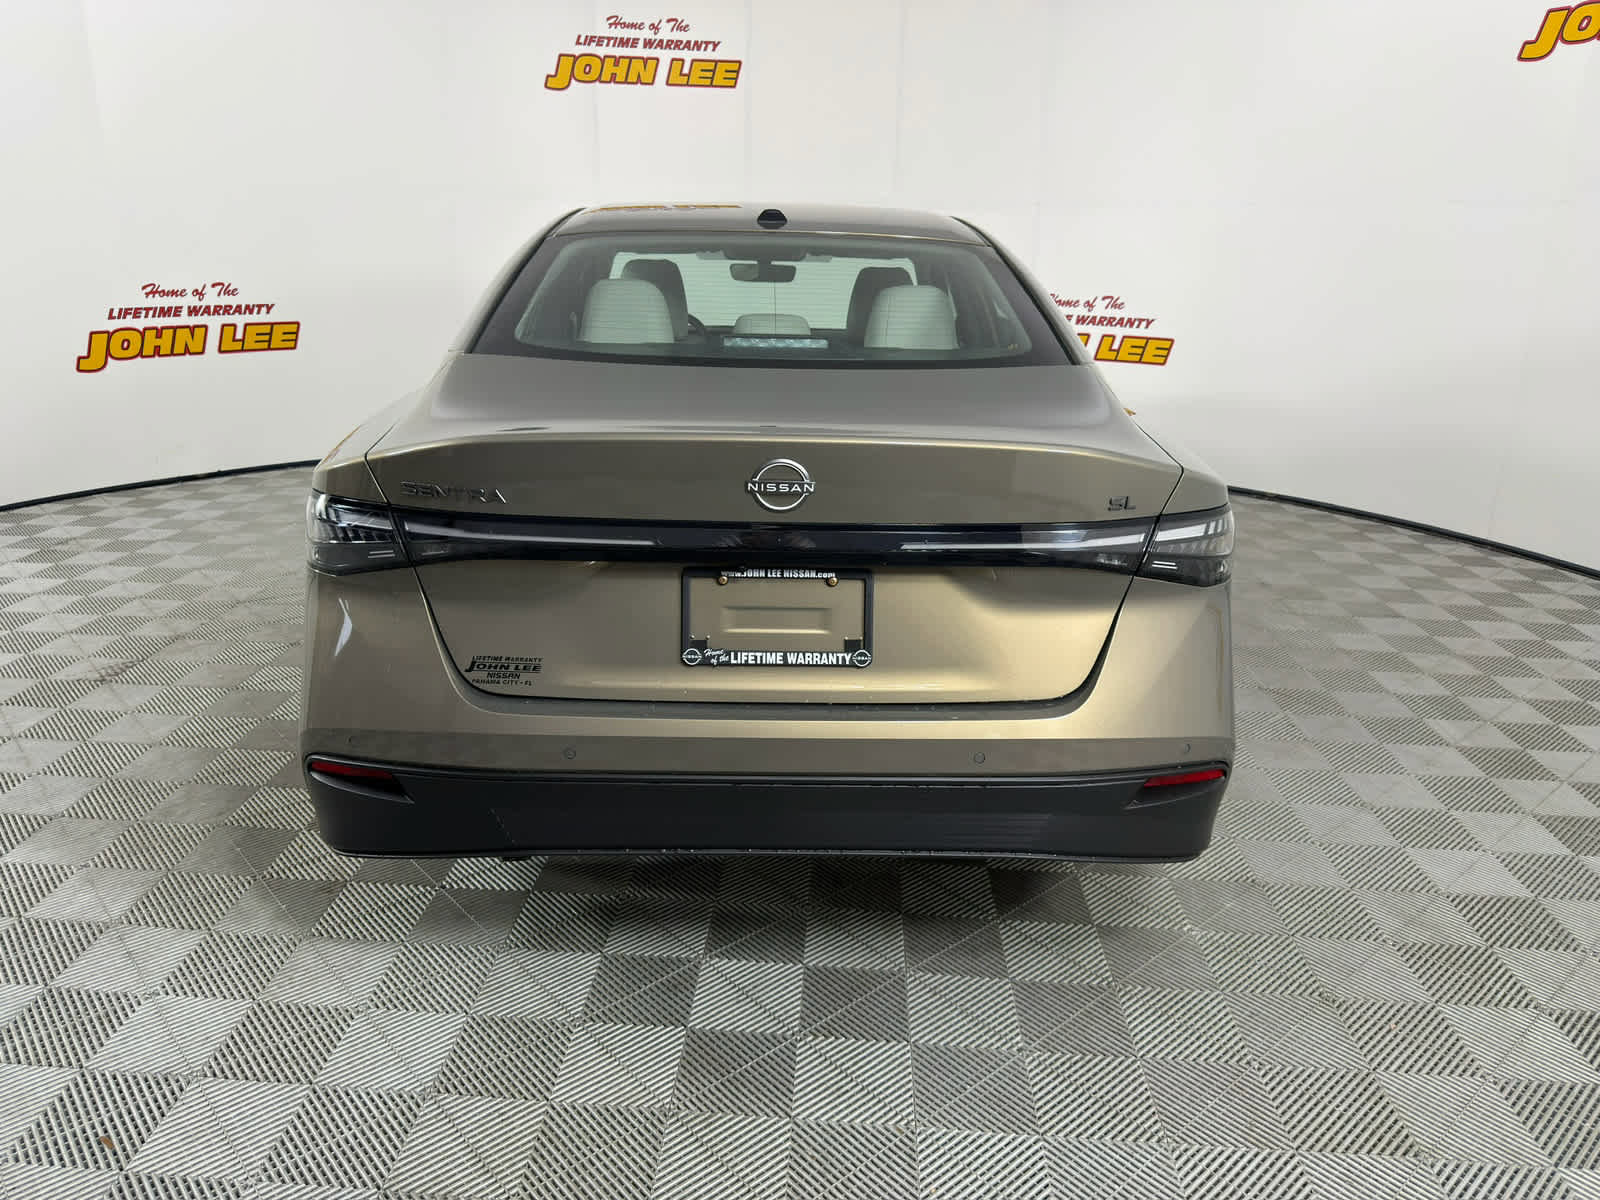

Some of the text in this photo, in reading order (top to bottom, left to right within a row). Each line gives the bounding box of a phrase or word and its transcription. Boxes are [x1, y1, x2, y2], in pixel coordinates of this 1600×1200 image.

[606, 15, 690, 35] Home of The
[1517, 0, 1600, 62] JO
[575, 34, 721, 52] LIFETIME WARRANTY
[544, 53, 742, 91] JOHN LEE
[141, 281, 239, 301] Home of The
[107, 303, 275, 320] LIFETIME WARRANTY
[1083, 296, 1098, 312] of
[1102, 295, 1126, 310] The
[1075, 314, 1156, 330] WARRANTY
[76, 321, 300, 373] JOHN LEE
[1094, 334, 1175, 366] LEE
[400, 480, 506, 504] SENTRA
[747, 482, 815, 493] NISSAN
[1107, 496, 1136, 511] SL
[767, 568, 782, 578] LEE
[464, 660, 542, 673] JOHN LEE
[730, 652, 853, 665] LIFETIME WARRANTY
[486, 672, 520, 680] NISSAN
